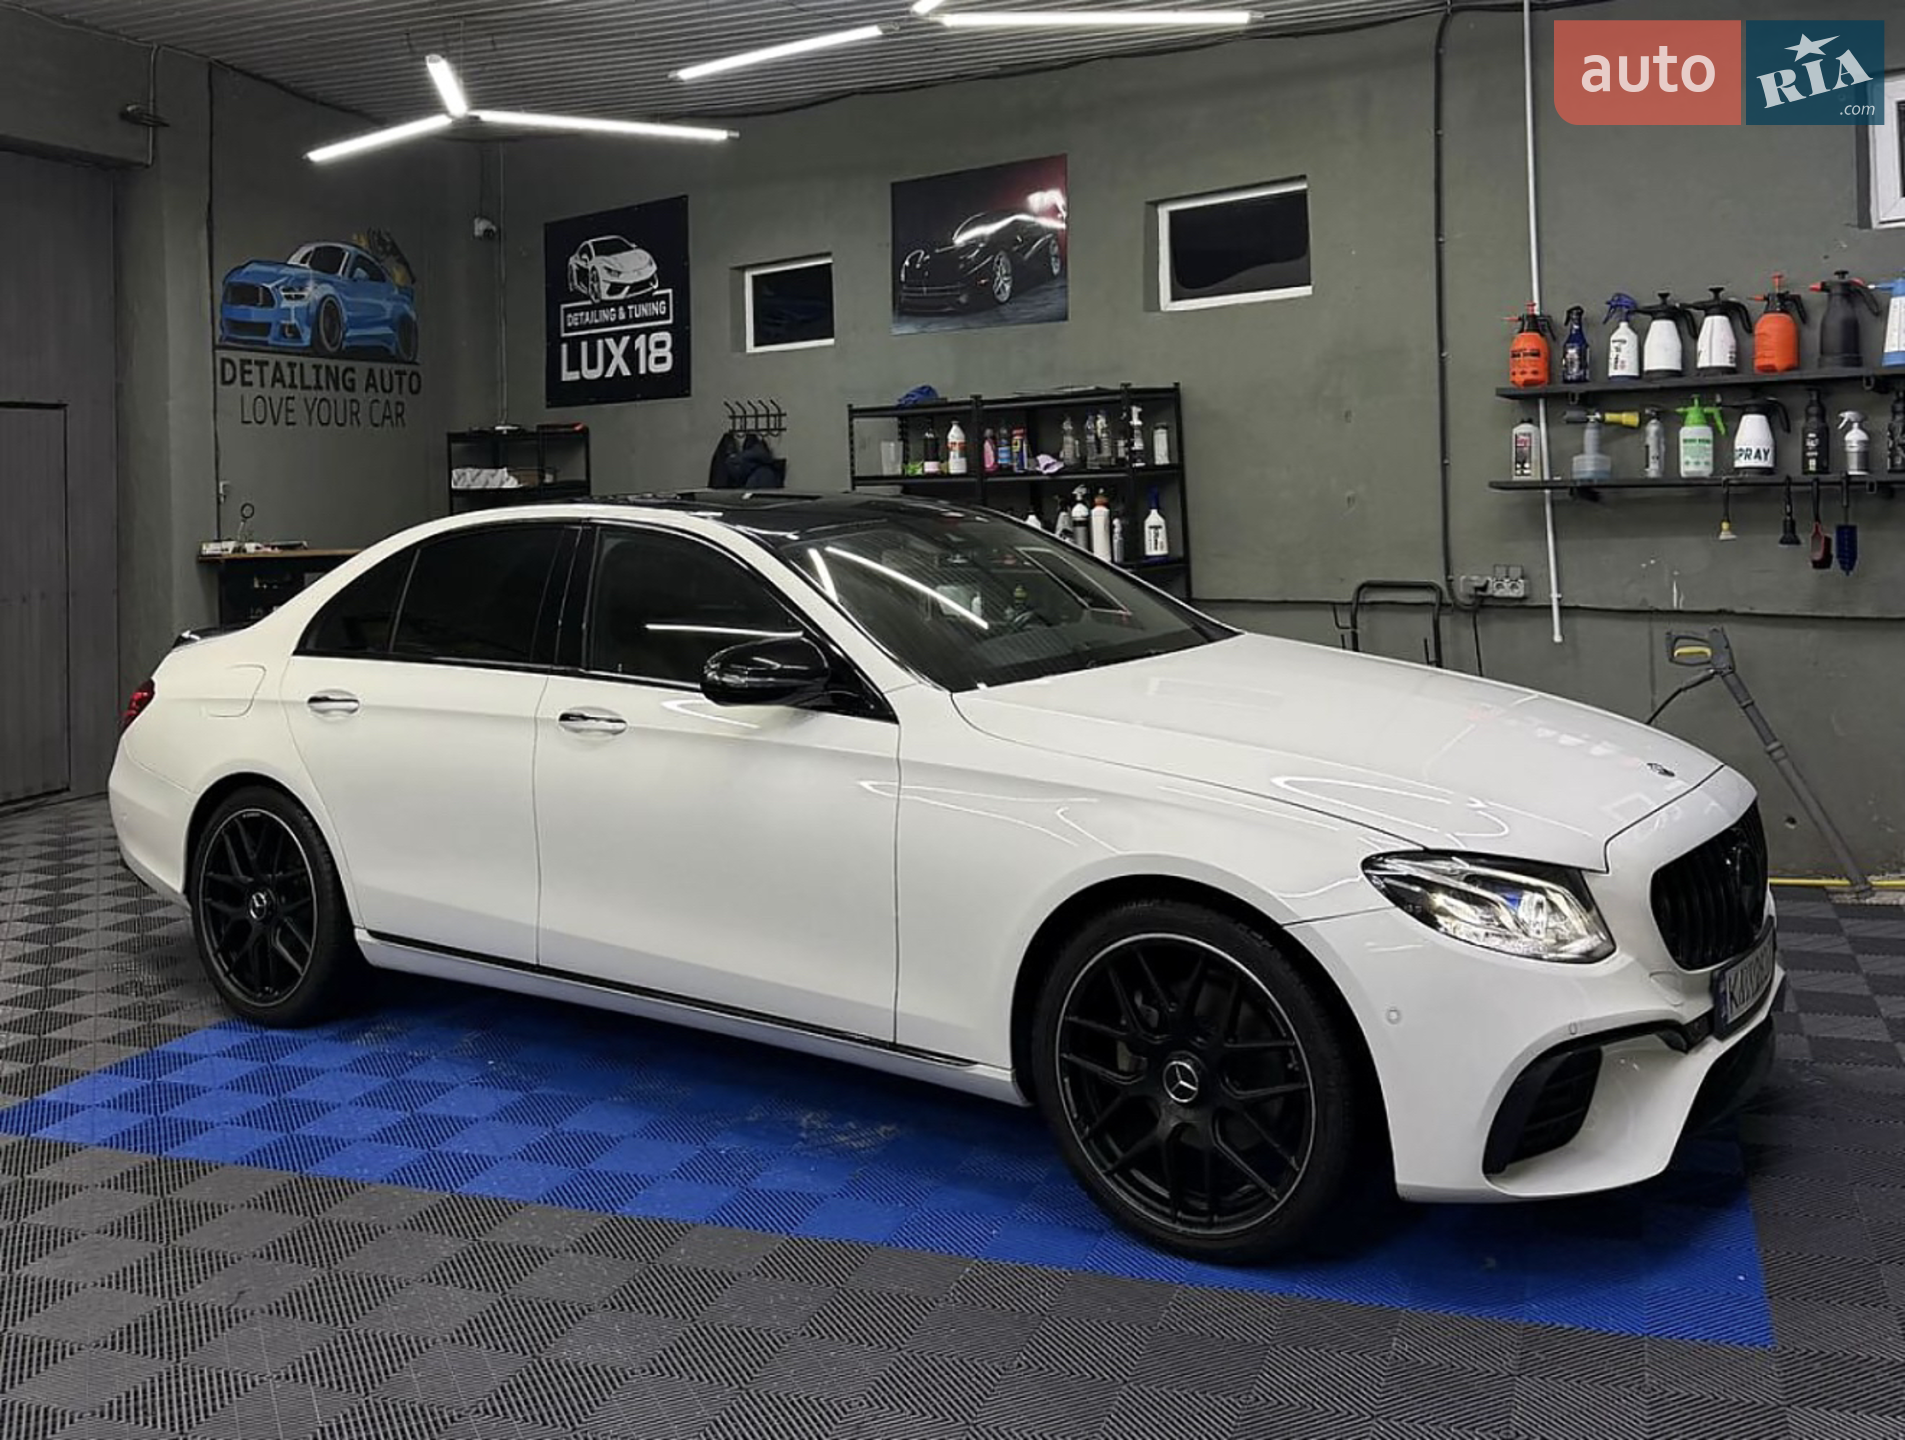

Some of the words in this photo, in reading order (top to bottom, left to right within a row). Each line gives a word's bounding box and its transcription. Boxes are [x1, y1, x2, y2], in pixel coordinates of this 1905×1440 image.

[566, 306, 617, 327] DETAILING
[618, 305, 626, 320] &
[627, 300, 667, 319] TUNING
[561, 331, 673, 381] LUX18
[220, 357, 357, 393] DETAILING
[364, 367, 422, 396] AUTO
[240, 394, 297, 426] LOVE
[304, 397, 361, 428] YOUR
[368, 398, 406, 429] CAR
